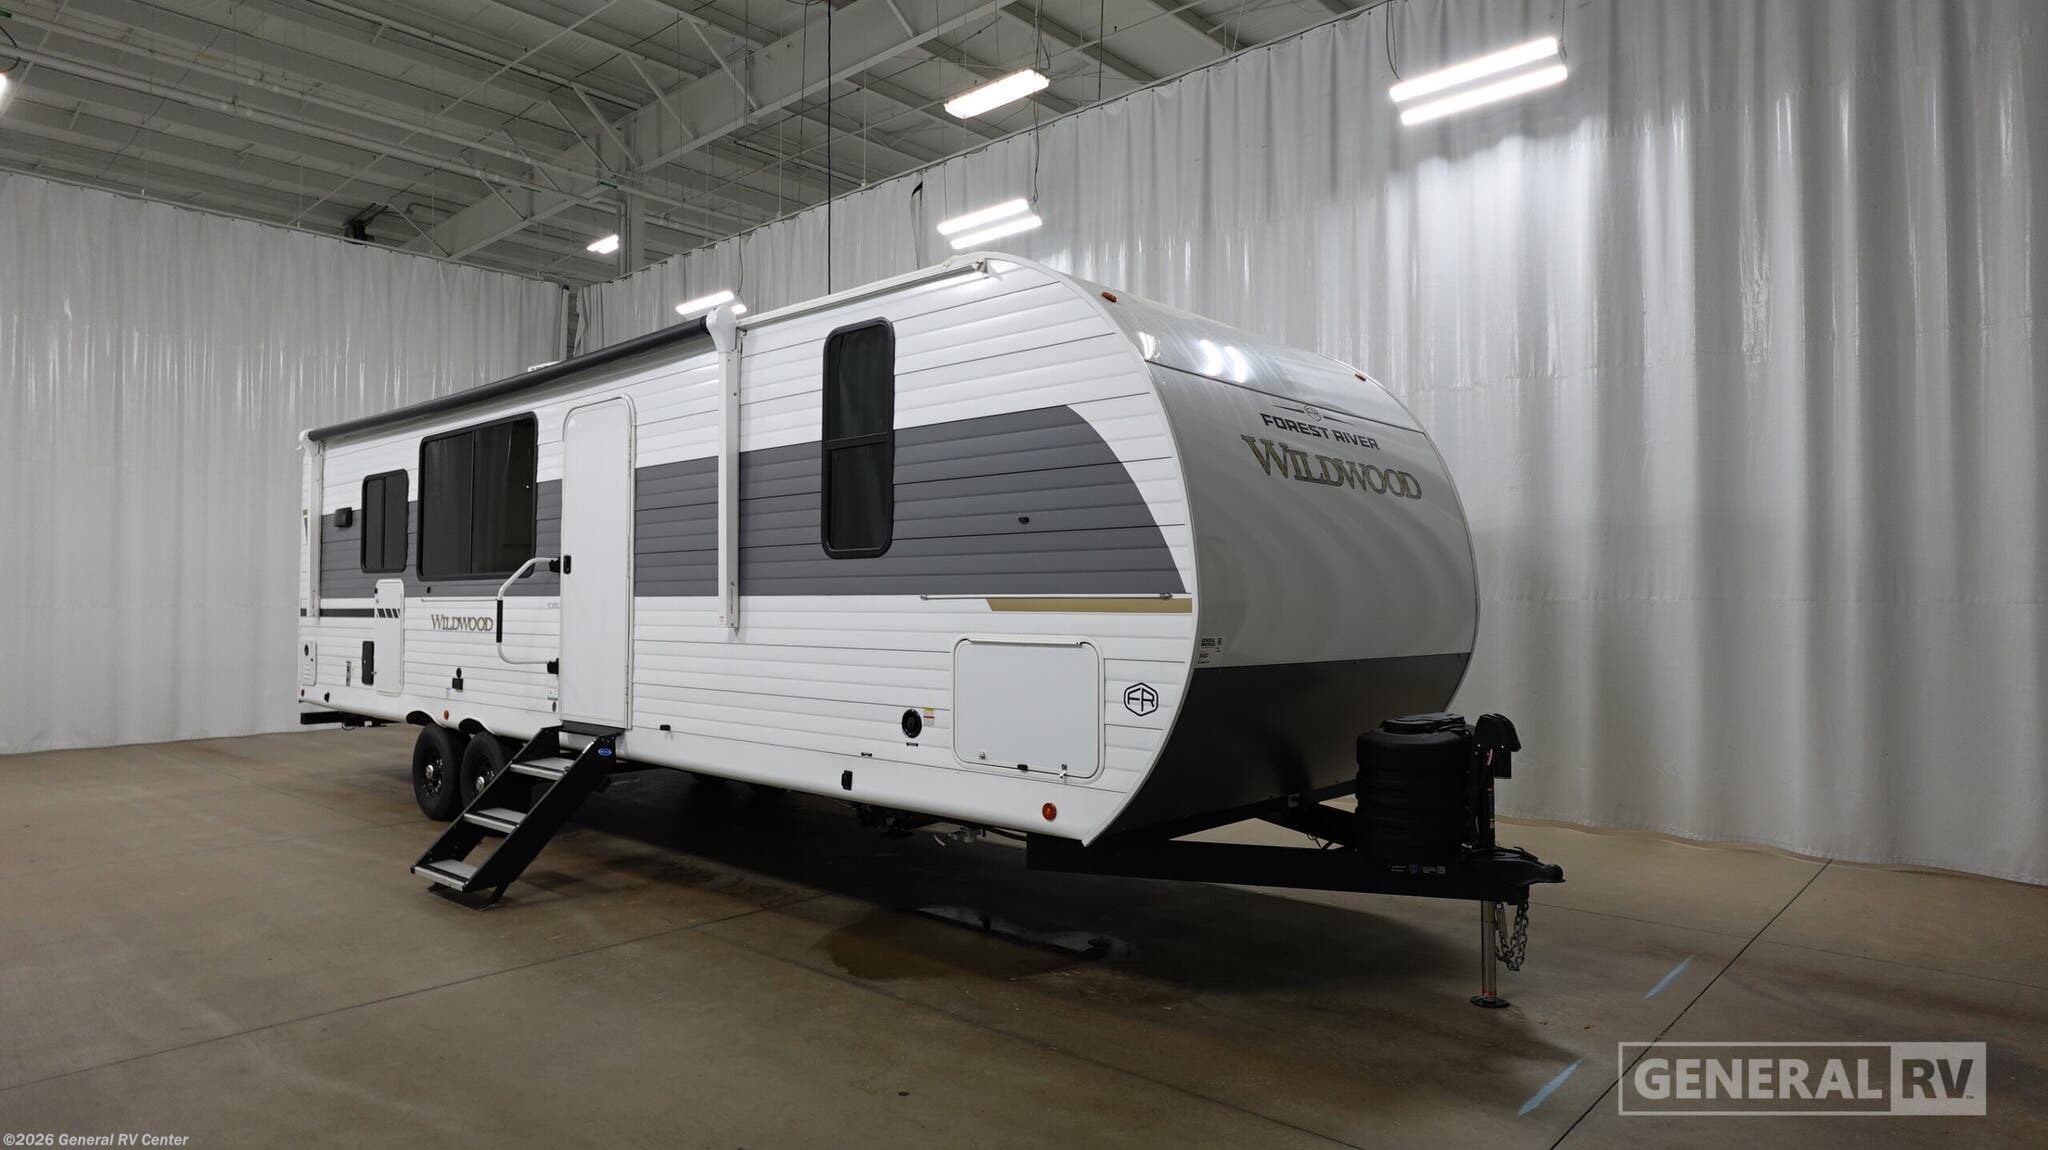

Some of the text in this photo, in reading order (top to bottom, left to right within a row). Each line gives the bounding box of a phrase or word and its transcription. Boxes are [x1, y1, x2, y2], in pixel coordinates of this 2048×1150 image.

[1260, 412, 1329, 440] FOREST
[1332, 429, 1382, 451] RIVER
[1240, 434, 1423, 500] WILDWOOD
[430, 613, 494, 632] WILDWOOD
